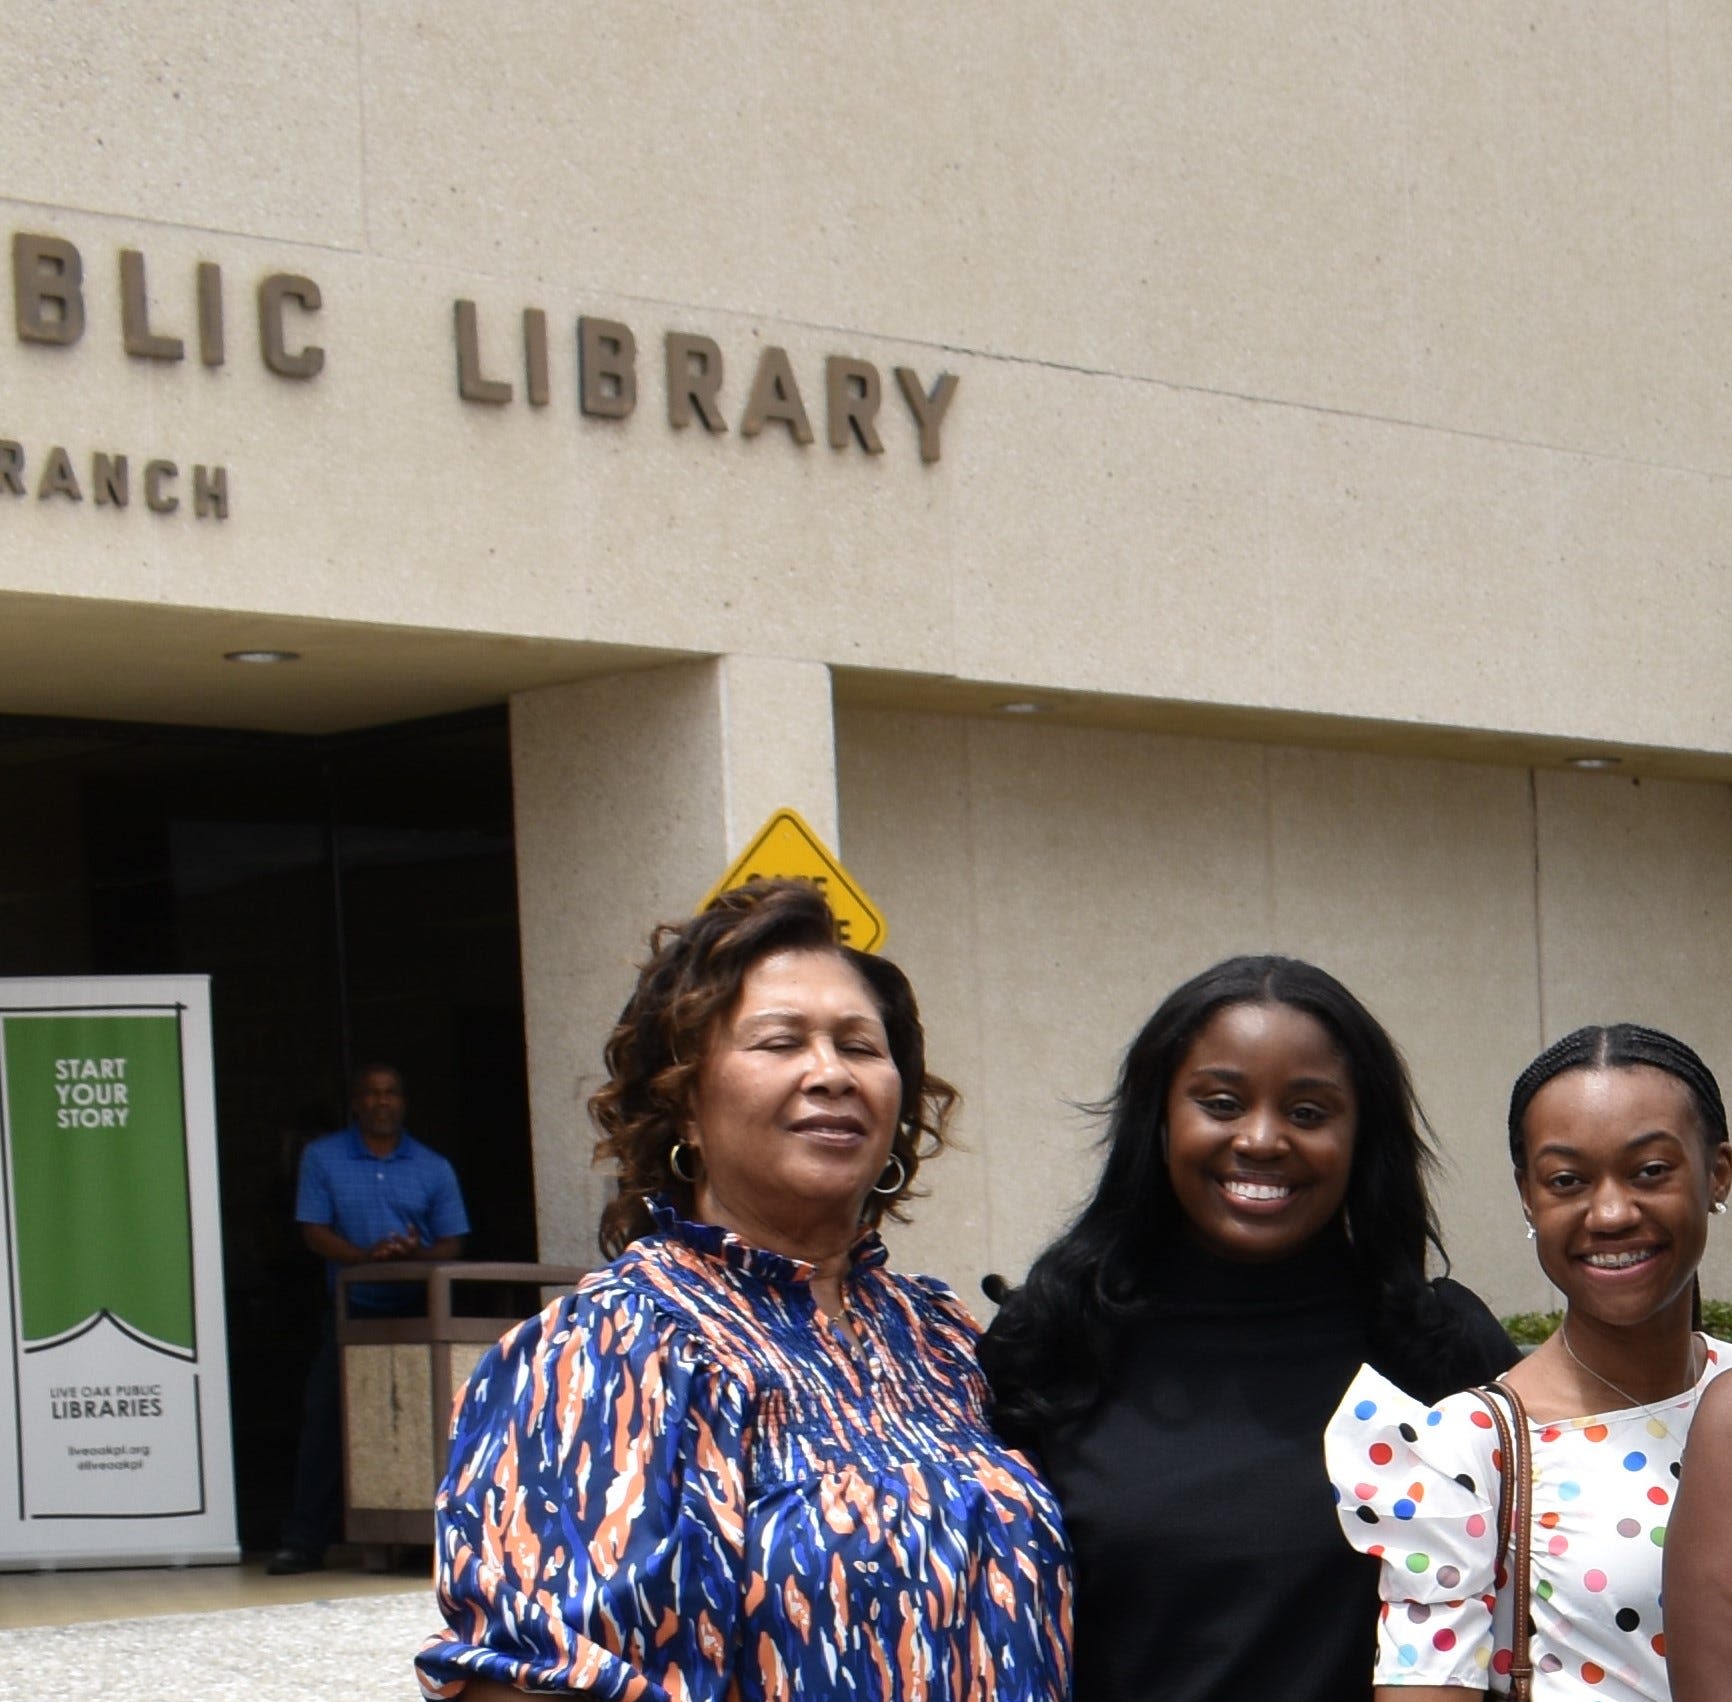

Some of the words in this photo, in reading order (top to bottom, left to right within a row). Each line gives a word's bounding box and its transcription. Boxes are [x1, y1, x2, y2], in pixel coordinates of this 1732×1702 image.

[13, 232, 325, 380] BLIC
[454, 299, 960, 464] LIBRARY
[55, 1058, 126, 1080] START
[55, 1083, 129, 1106] YOUR
[57, 1107, 129, 1129] STORY
[50, 1387, 77, 1399] LIVE
[81, 1386, 111, 1398] OAK
[116, 1384, 162, 1397] PUBLIC
[51, 1398, 162, 1420] LIBRARIES
